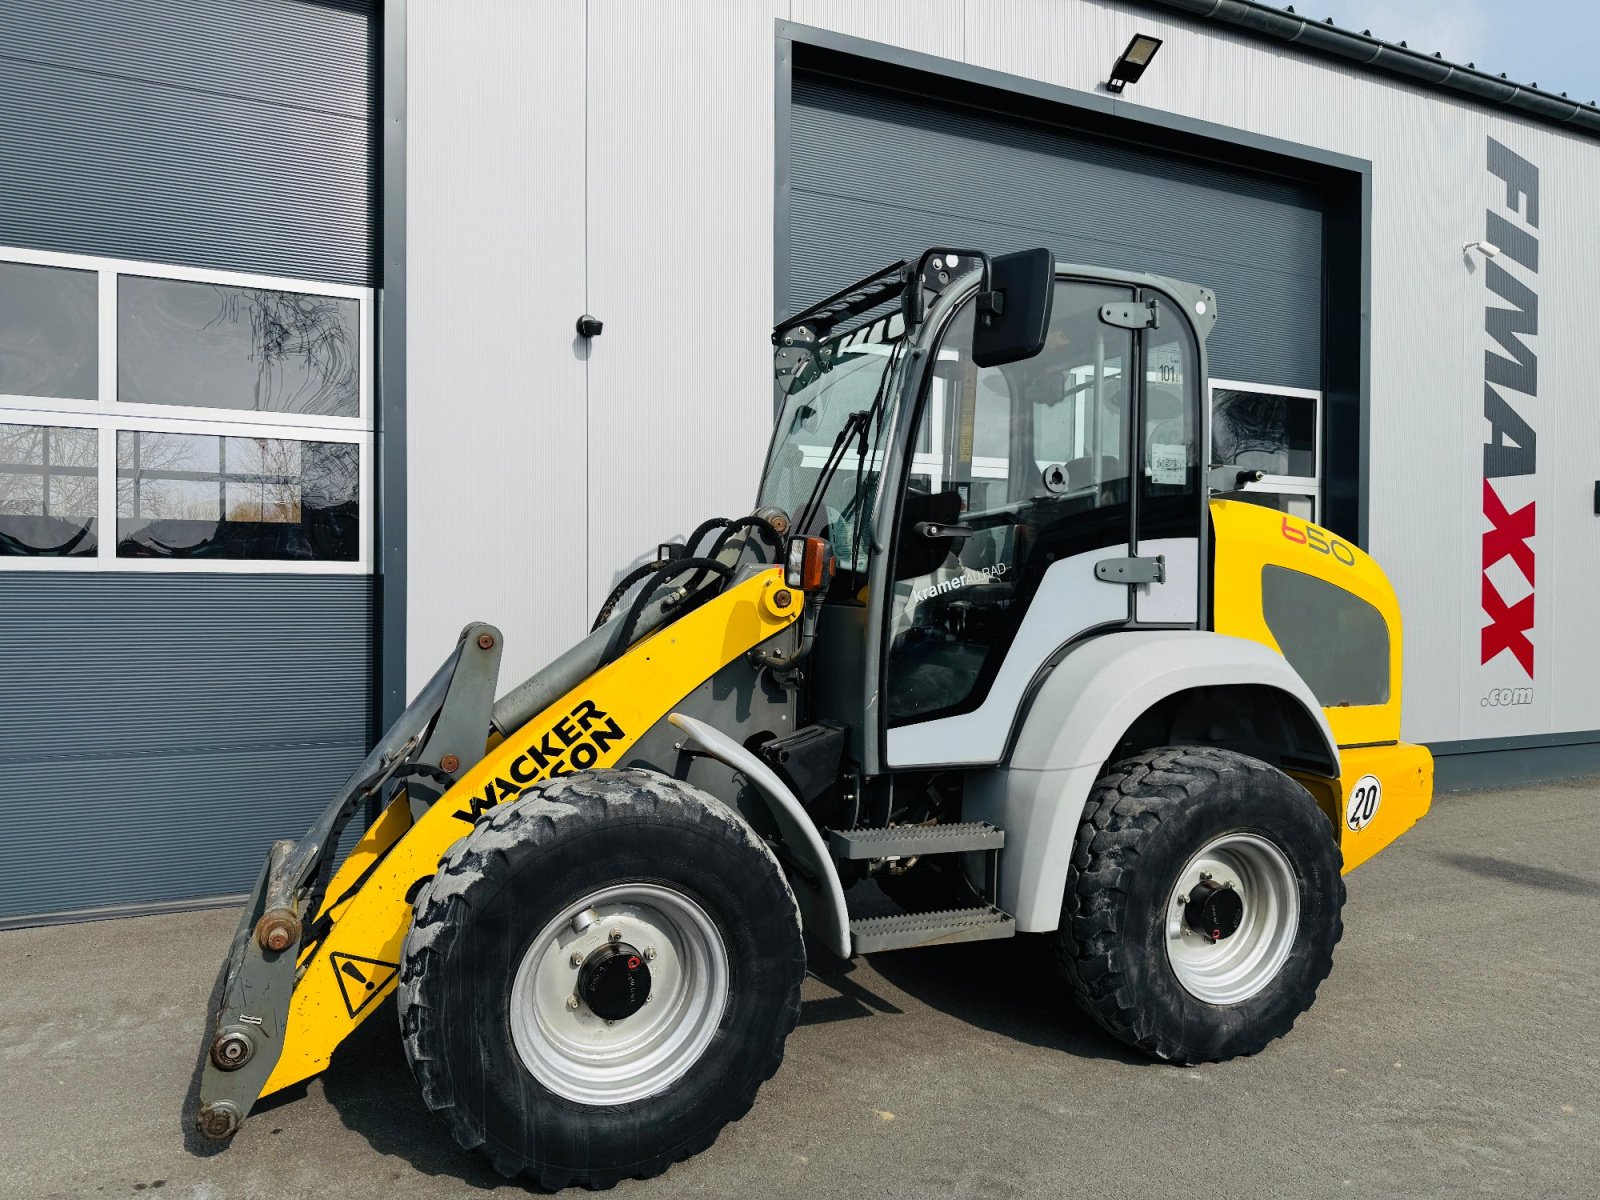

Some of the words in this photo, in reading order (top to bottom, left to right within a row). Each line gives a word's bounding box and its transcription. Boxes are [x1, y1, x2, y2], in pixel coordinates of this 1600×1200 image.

[1158, 364, 1175, 383] 101
[1481, 134, 1539, 681] FIMAXX
[451, 699, 608, 825] WACKER
[1349, 785, 1377, 823] 20
